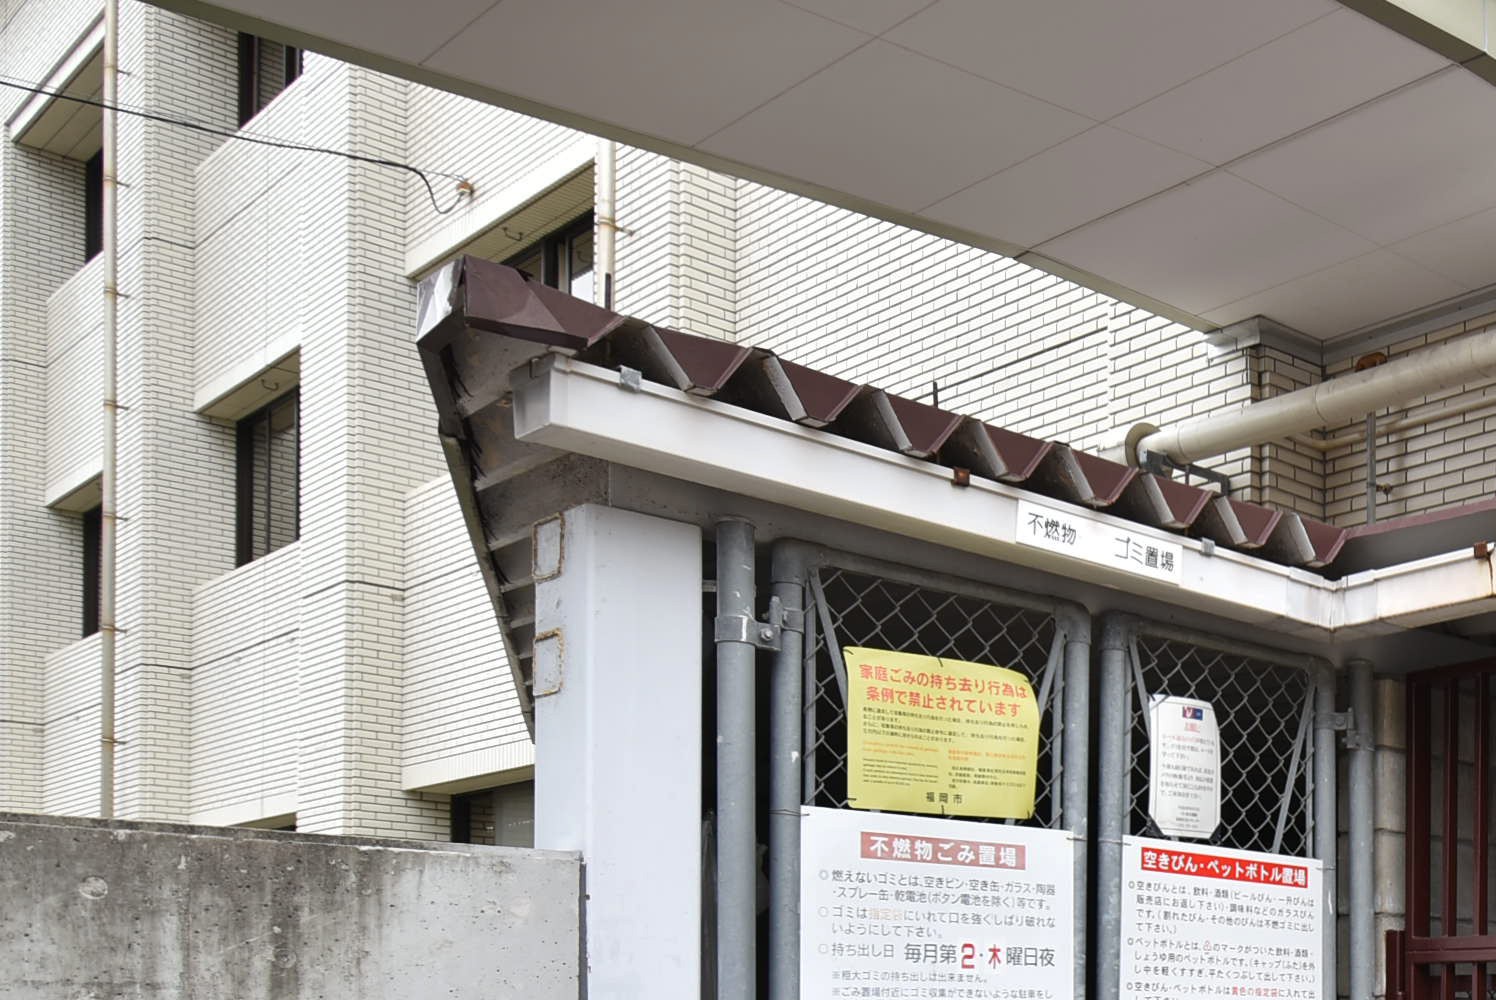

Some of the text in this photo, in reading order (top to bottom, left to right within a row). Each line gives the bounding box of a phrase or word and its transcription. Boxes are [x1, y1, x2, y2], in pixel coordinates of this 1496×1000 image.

[1027, 511, 1174, 572] 不燃物 ゴミ置場
[858, 663, 1030, 699] 家庭ごみの持ち去り行為は
[866, 686, 1021, 717] 条例で禁止されています
[926, 791, 963, 805] 福岡市
[869, 835, 1018, 867] 不燃物ごみ置場
[831, 943, 895, 958] 持ち出し日
